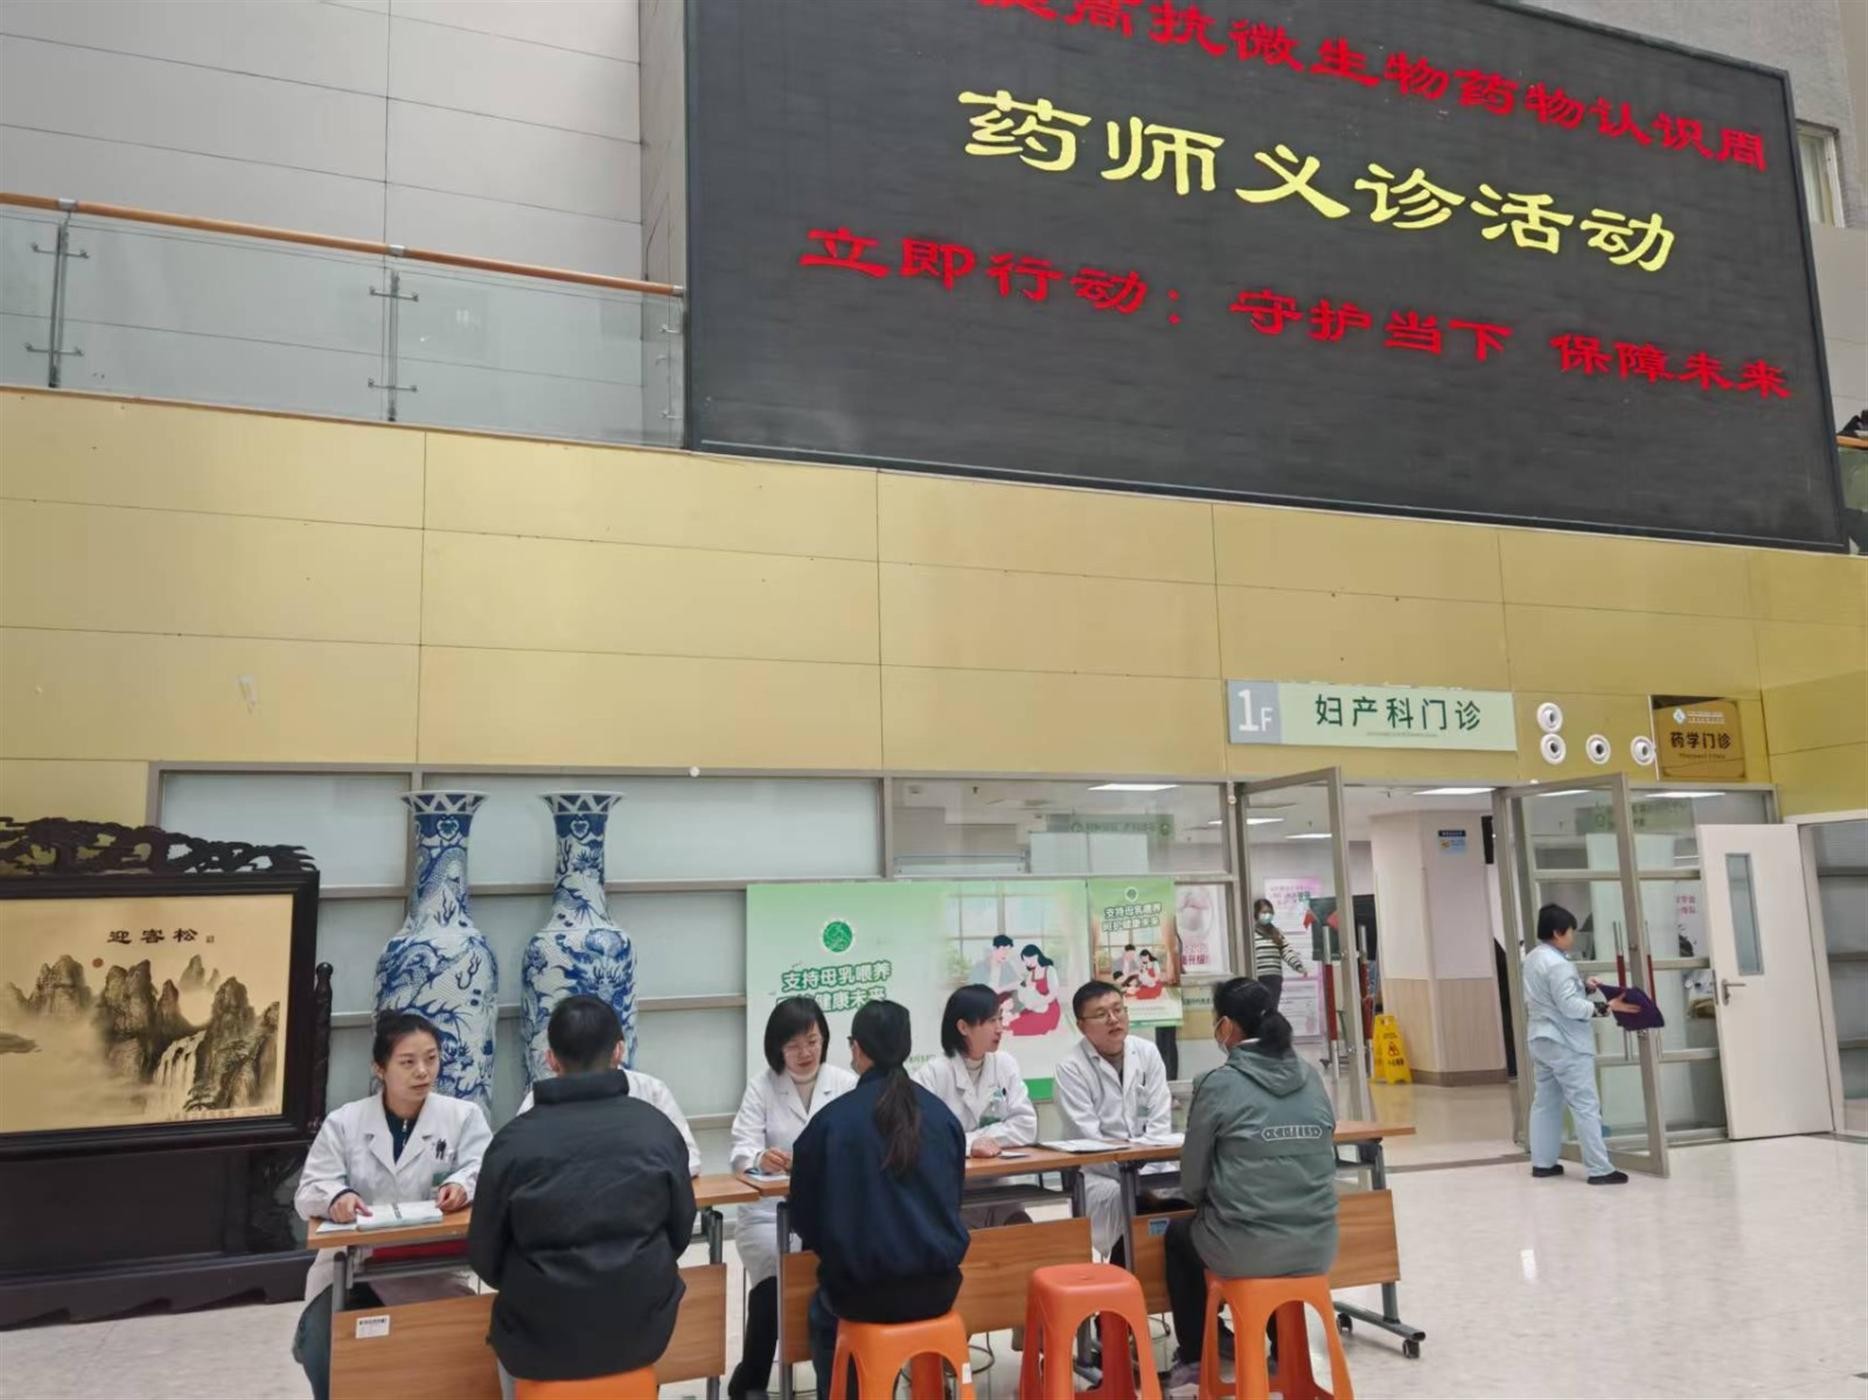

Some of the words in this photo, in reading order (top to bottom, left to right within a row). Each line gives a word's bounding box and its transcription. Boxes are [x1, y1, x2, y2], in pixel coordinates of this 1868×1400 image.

[958, 90, 1675, 271] 药师义诊活动
[1549, 332, 1791, 399] 保障未来
[1237, 688, 1274, 732] 1F
[1315, 693, 1482, 732] 妇产科门诊
[1669, 730, 1732, 750] 药学门诊
[106, 927, 199, 945] 迎客松
[781, 960, 893, 993] 支持母乳喂养
